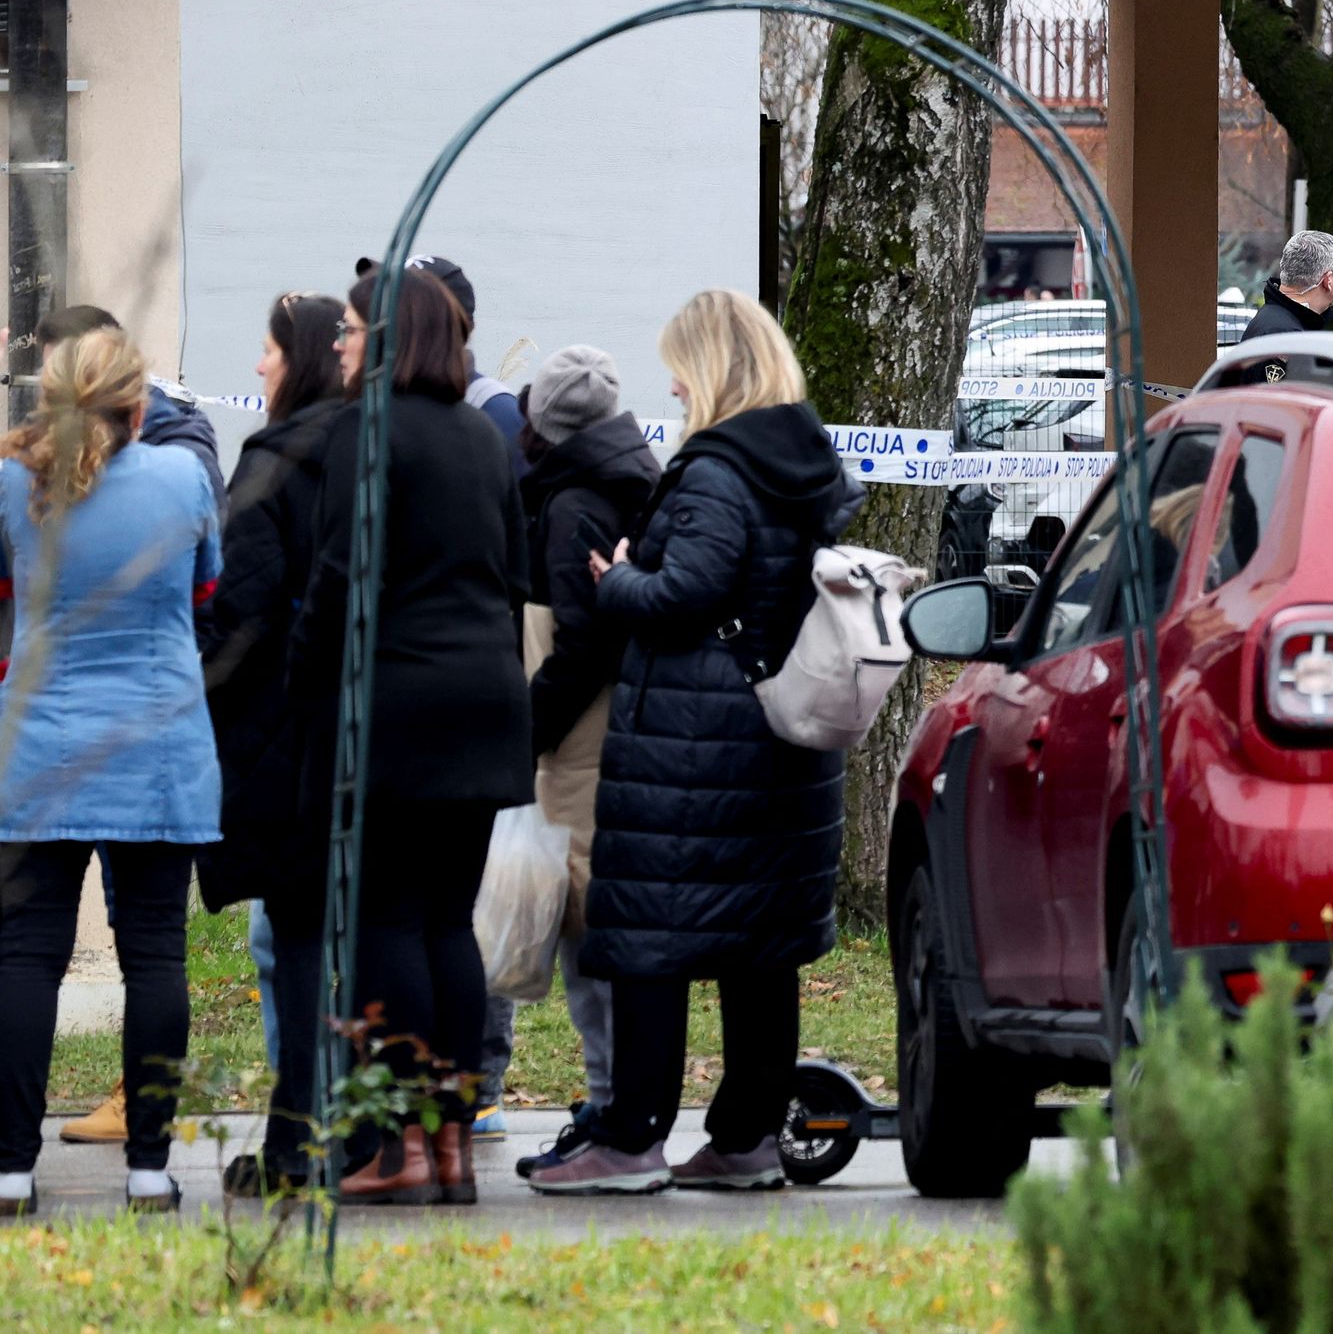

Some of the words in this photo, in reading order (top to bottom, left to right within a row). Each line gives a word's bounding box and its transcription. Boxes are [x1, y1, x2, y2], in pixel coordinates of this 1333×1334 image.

[829, 432, 905, 454] LICIJA
[905, 460, 947, 480] STOP
[951, 458, 983, 479] POLICIJA
[999, 458, 1018, 478] STOP
[1021, 457, 1052, 478] POLICIJA
[1065, 457, 1085, 478] STOP
